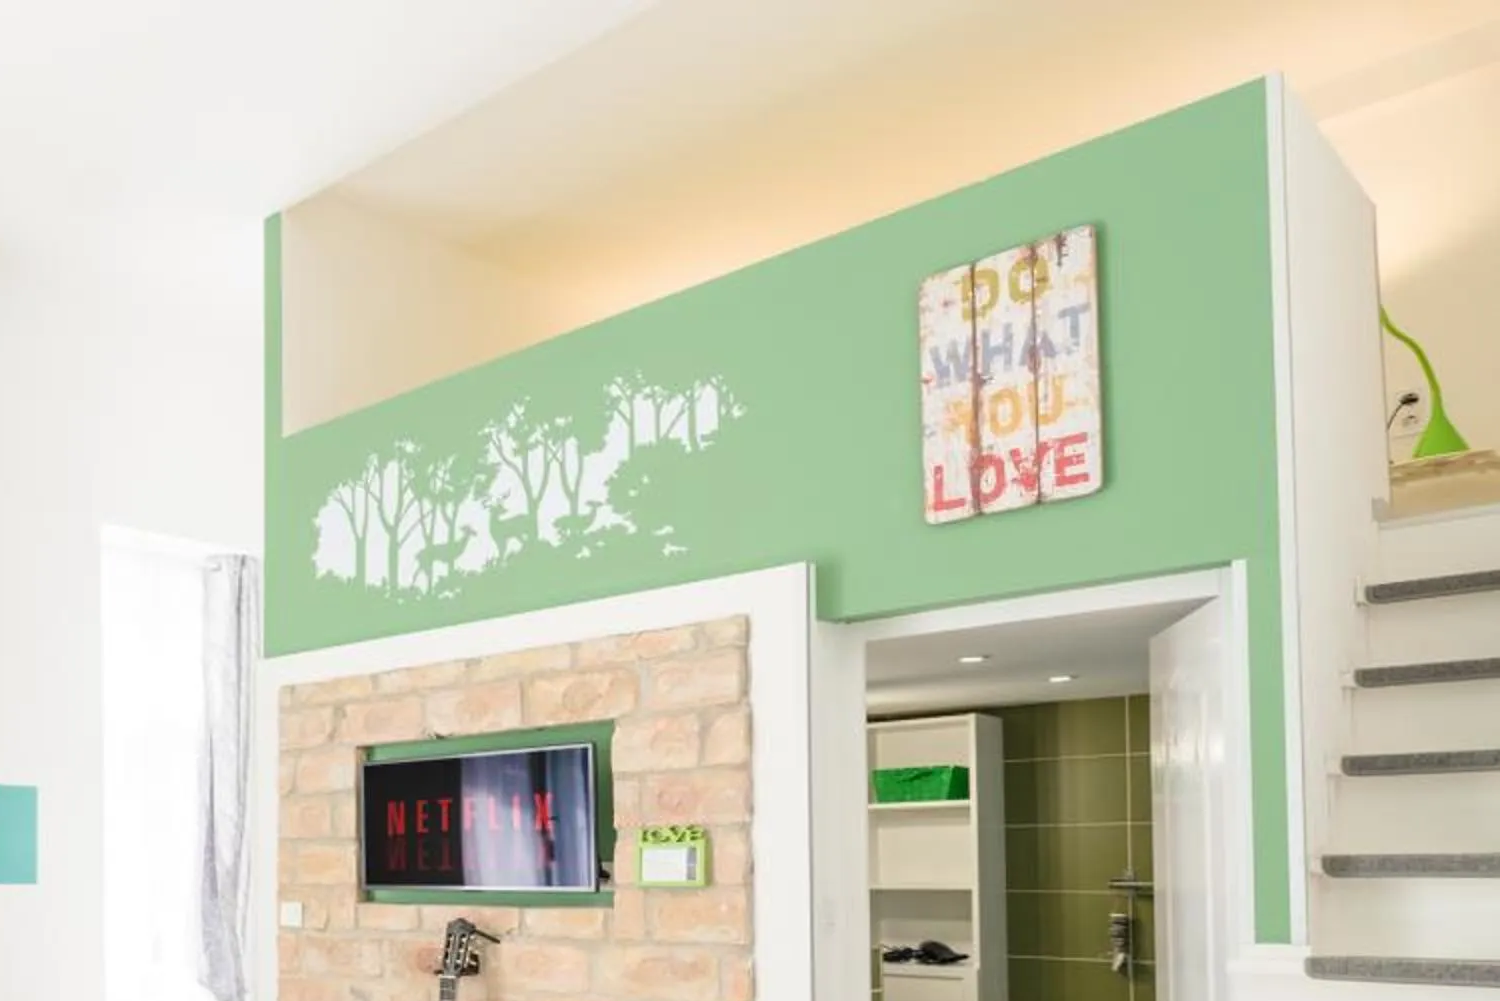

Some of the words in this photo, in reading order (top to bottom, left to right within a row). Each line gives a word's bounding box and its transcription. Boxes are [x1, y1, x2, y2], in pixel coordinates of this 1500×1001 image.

[961, 254, 1051, 322] DO
[929, 302, 1093, 390] WHAT
[942, 375, 1065, 446] YOU
[932, 431, 1091, 513] LOVE
[387, 792, 554, 835] NETFLIX
